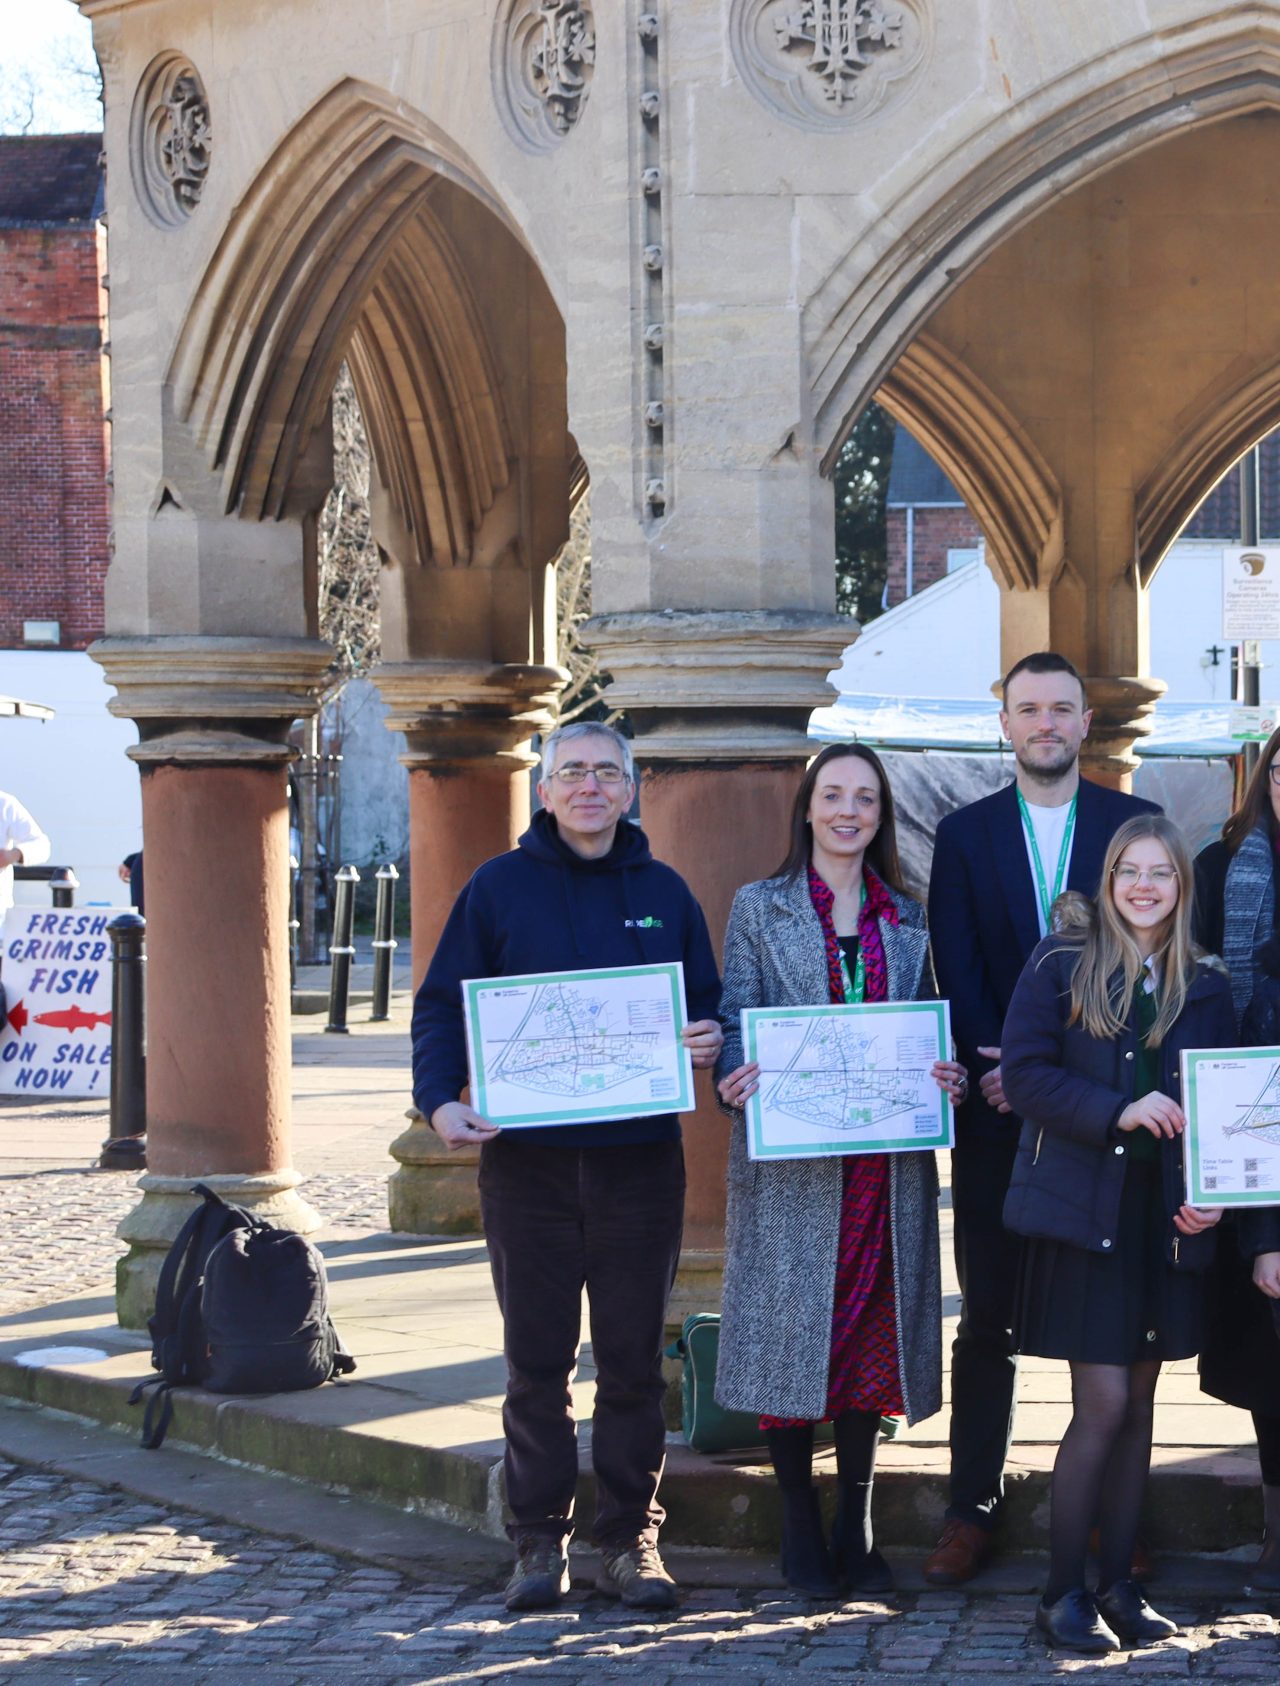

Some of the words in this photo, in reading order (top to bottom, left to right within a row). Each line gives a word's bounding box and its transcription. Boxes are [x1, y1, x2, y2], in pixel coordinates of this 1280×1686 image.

[27, 913, 108, 936] FRESH
[8, 939, 112, 963] GRIMSB
[29, 968, 100, 995] FISH
[2, 1041, 38, 1063] ON
[53, 1042, 112, 1065] SALE
[15, 1068, 73, 1090] NOW
